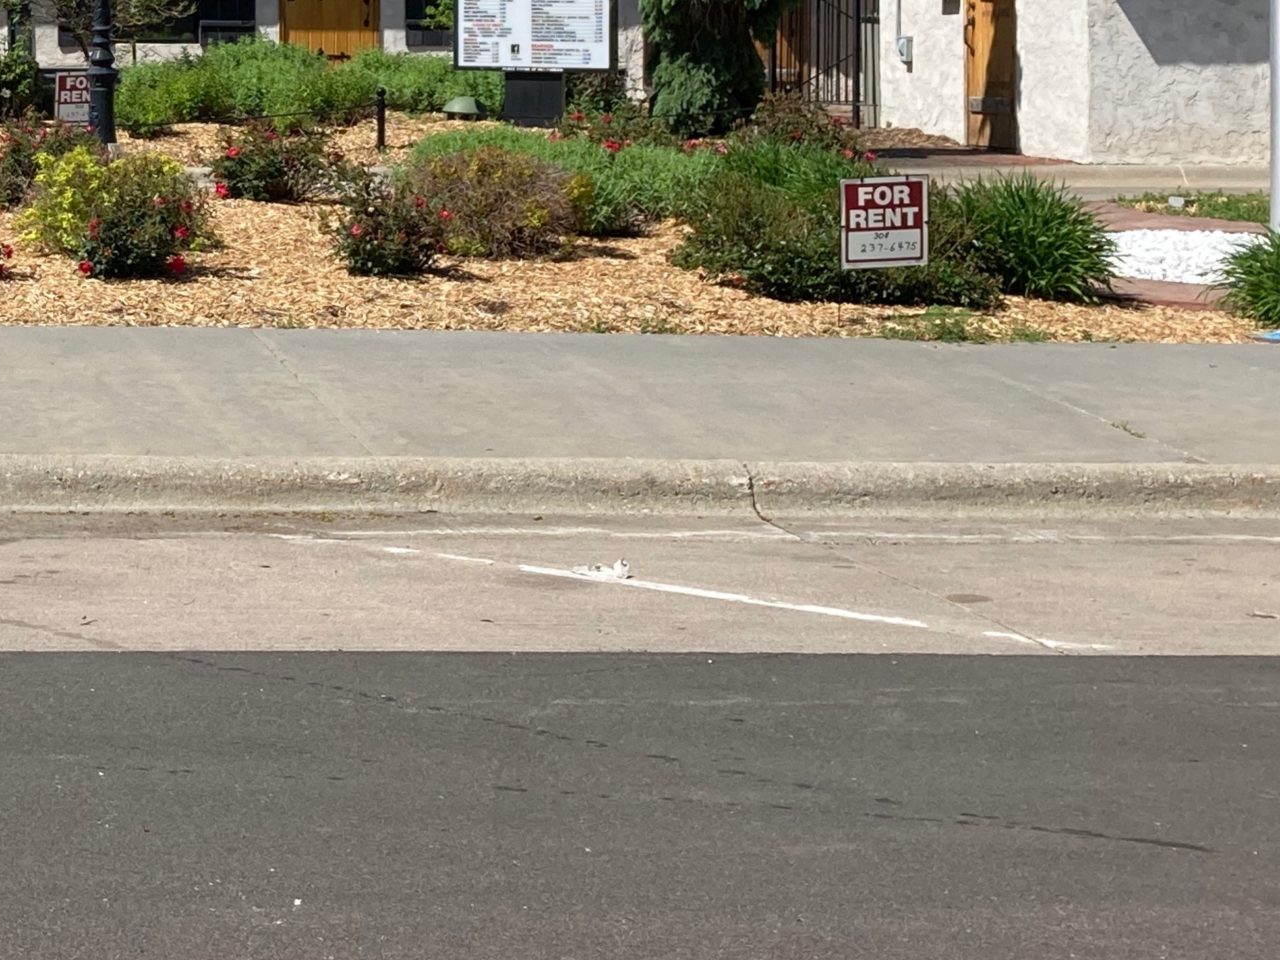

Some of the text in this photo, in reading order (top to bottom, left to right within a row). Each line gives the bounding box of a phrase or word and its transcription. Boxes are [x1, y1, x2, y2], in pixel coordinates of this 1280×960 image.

[65, 76, 91, 90] FO
[60, 90, 91, 103] REN
[858, 185, 911, 207] FOR
[849, 207, 920, 229] RENT
